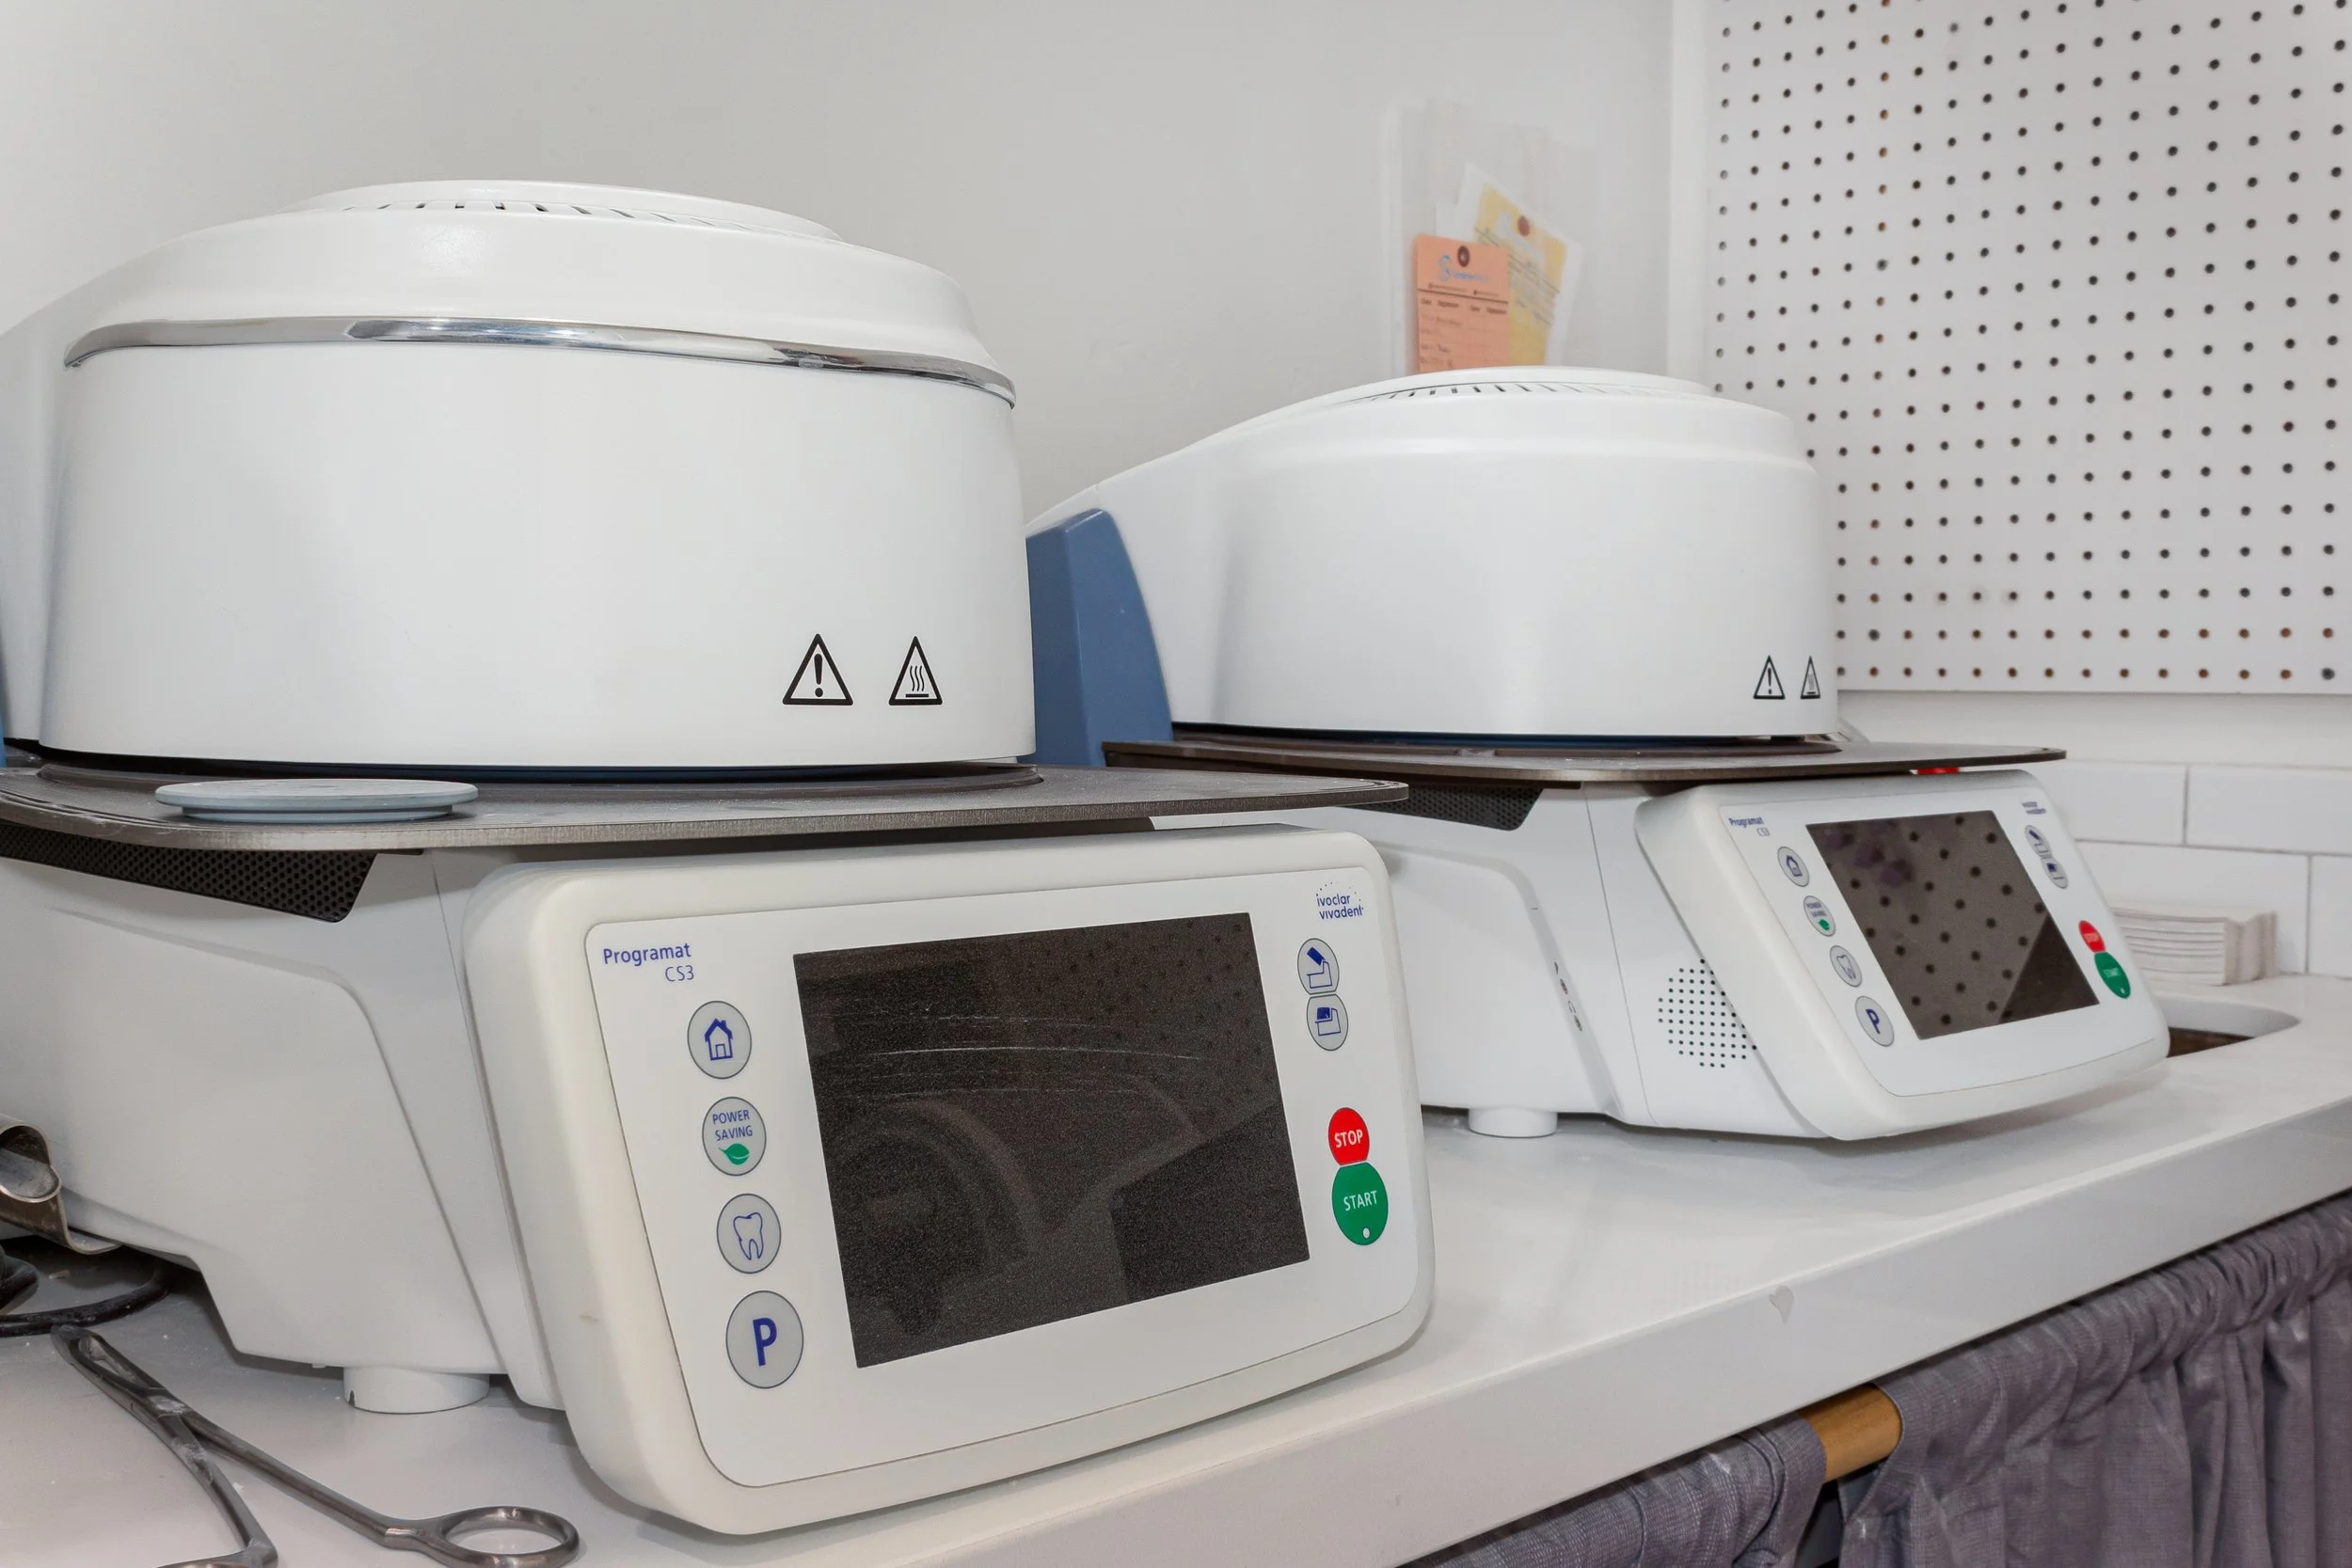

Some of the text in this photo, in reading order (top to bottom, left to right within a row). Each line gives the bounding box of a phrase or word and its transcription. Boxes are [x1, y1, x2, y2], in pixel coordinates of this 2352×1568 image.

[1316, 893, 1350, 907] ivoclar
[1319, 905, 1363, 920] vivadent
[603, 942, 691, 967] Programat
[664, 965, 695, 982] CS3
[1866, 1008, 1881, 1035] P
[712, 1110, 751, 1125] POWER
[715, 1125, 754, 1142] SAVING
[1334, 1129, 1363, 1148] STOP
[1343, 1190, 1378, 1212] START
[753, 1317, 777, 1367] P
